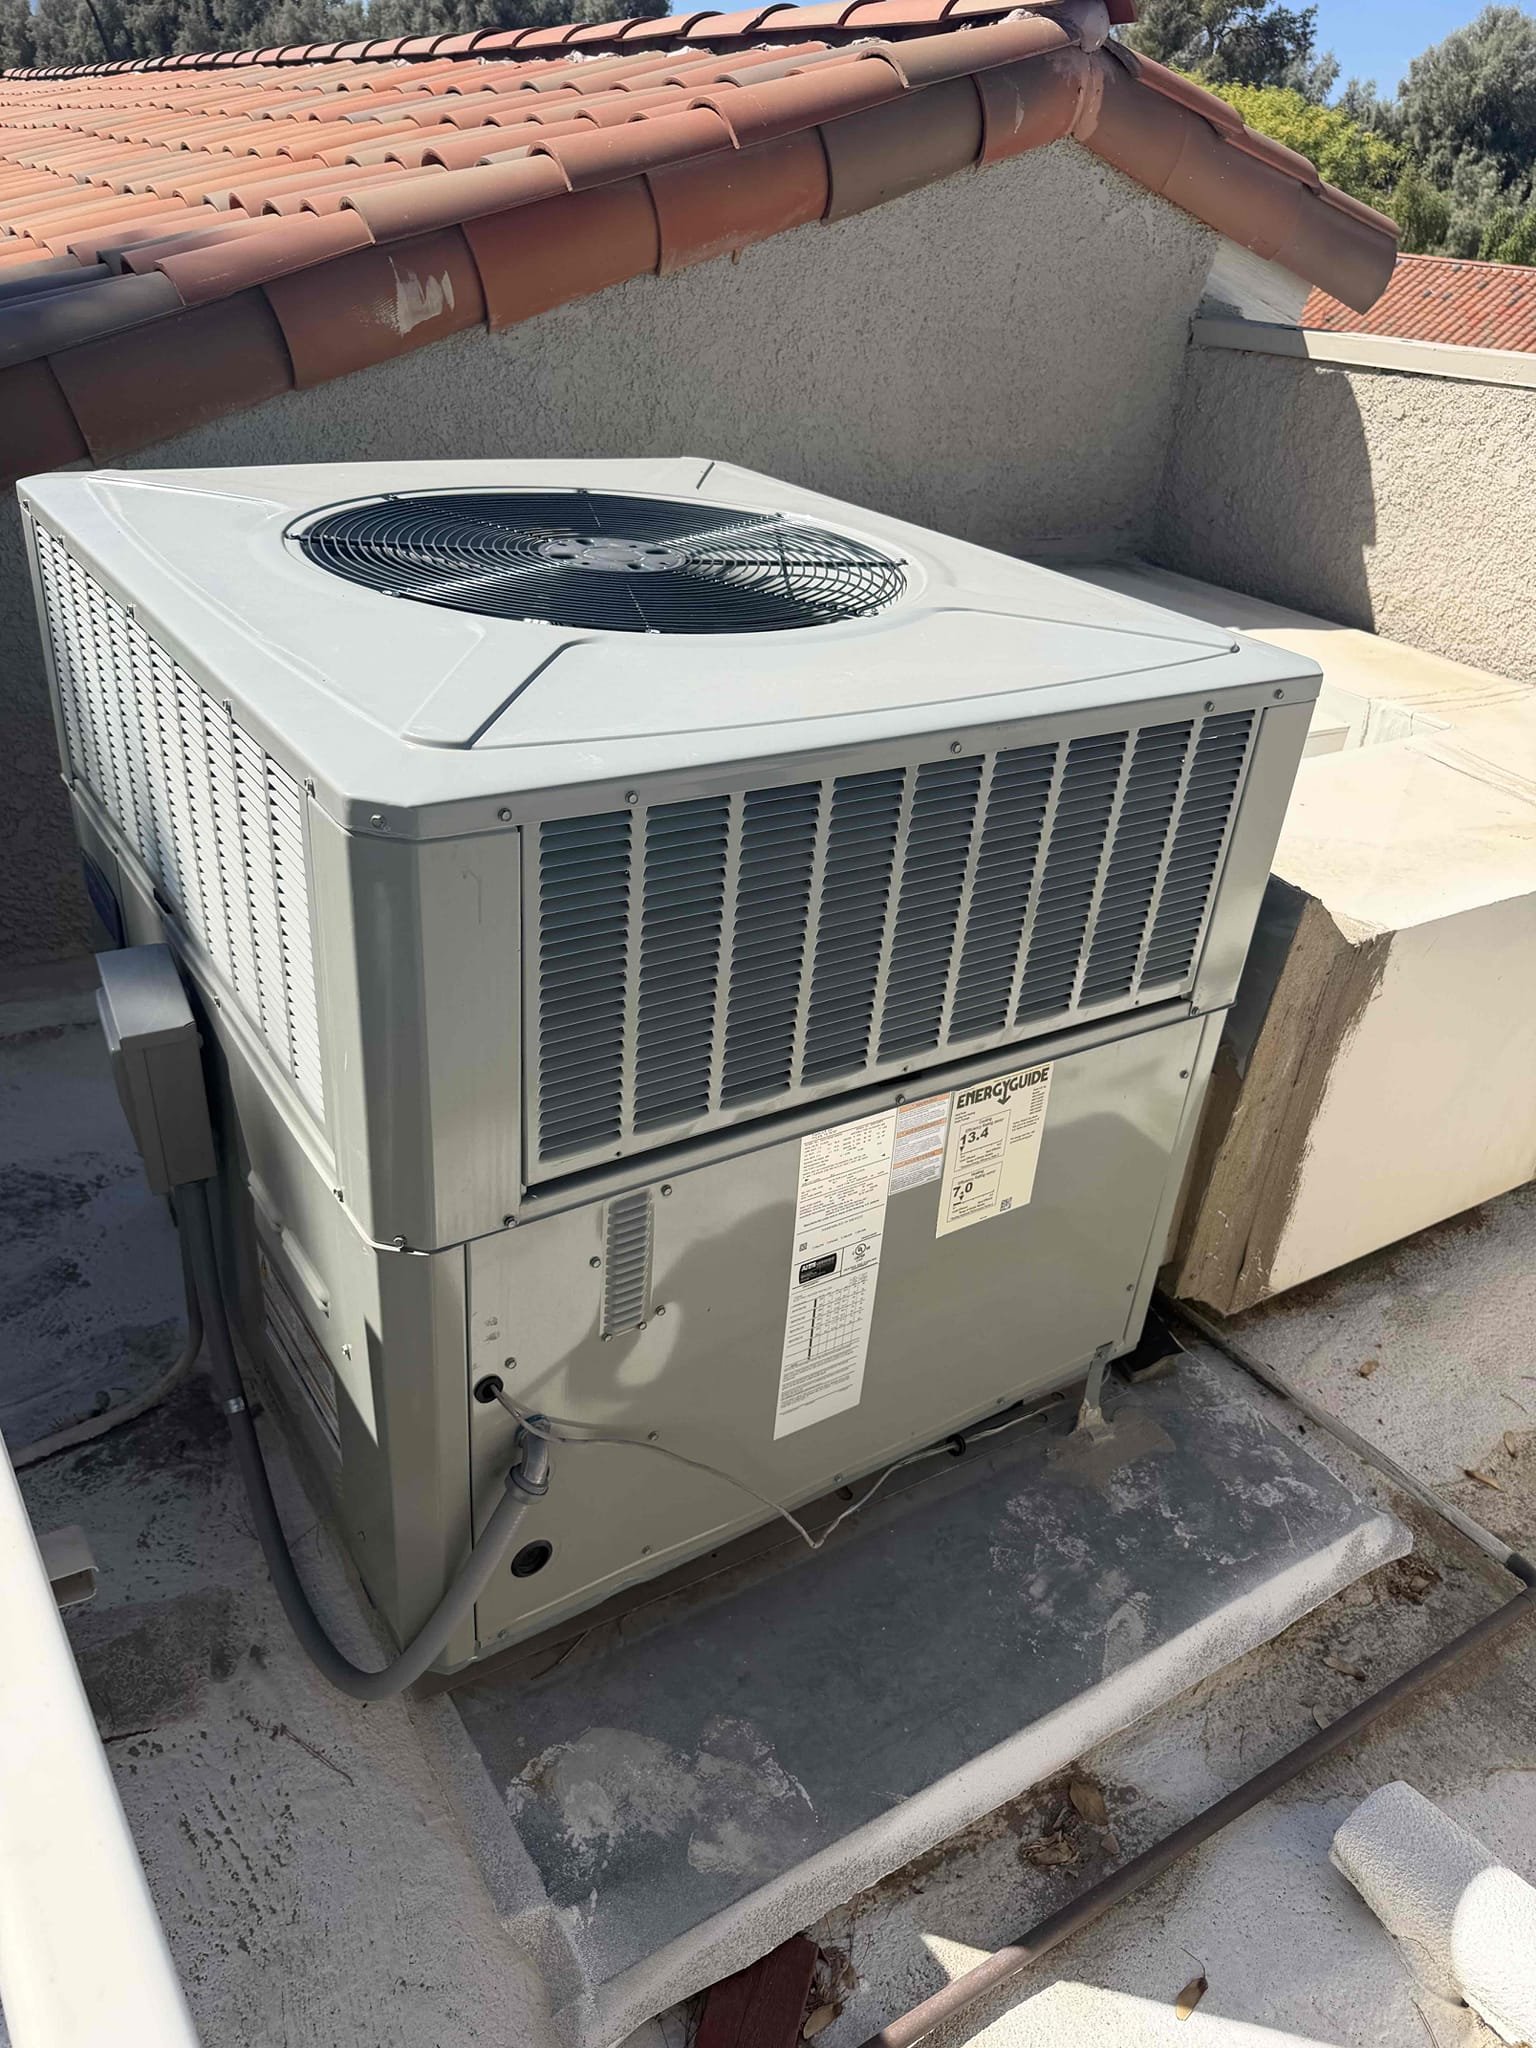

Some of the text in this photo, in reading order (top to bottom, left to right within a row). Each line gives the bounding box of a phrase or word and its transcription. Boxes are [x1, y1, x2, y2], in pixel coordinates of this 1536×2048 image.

[956, 1067, 1049, 1109] ENERGYGUIDE
[960, 1127, 988, 1145] 13.4
[953, 1182, 973, 1197] 7.0
